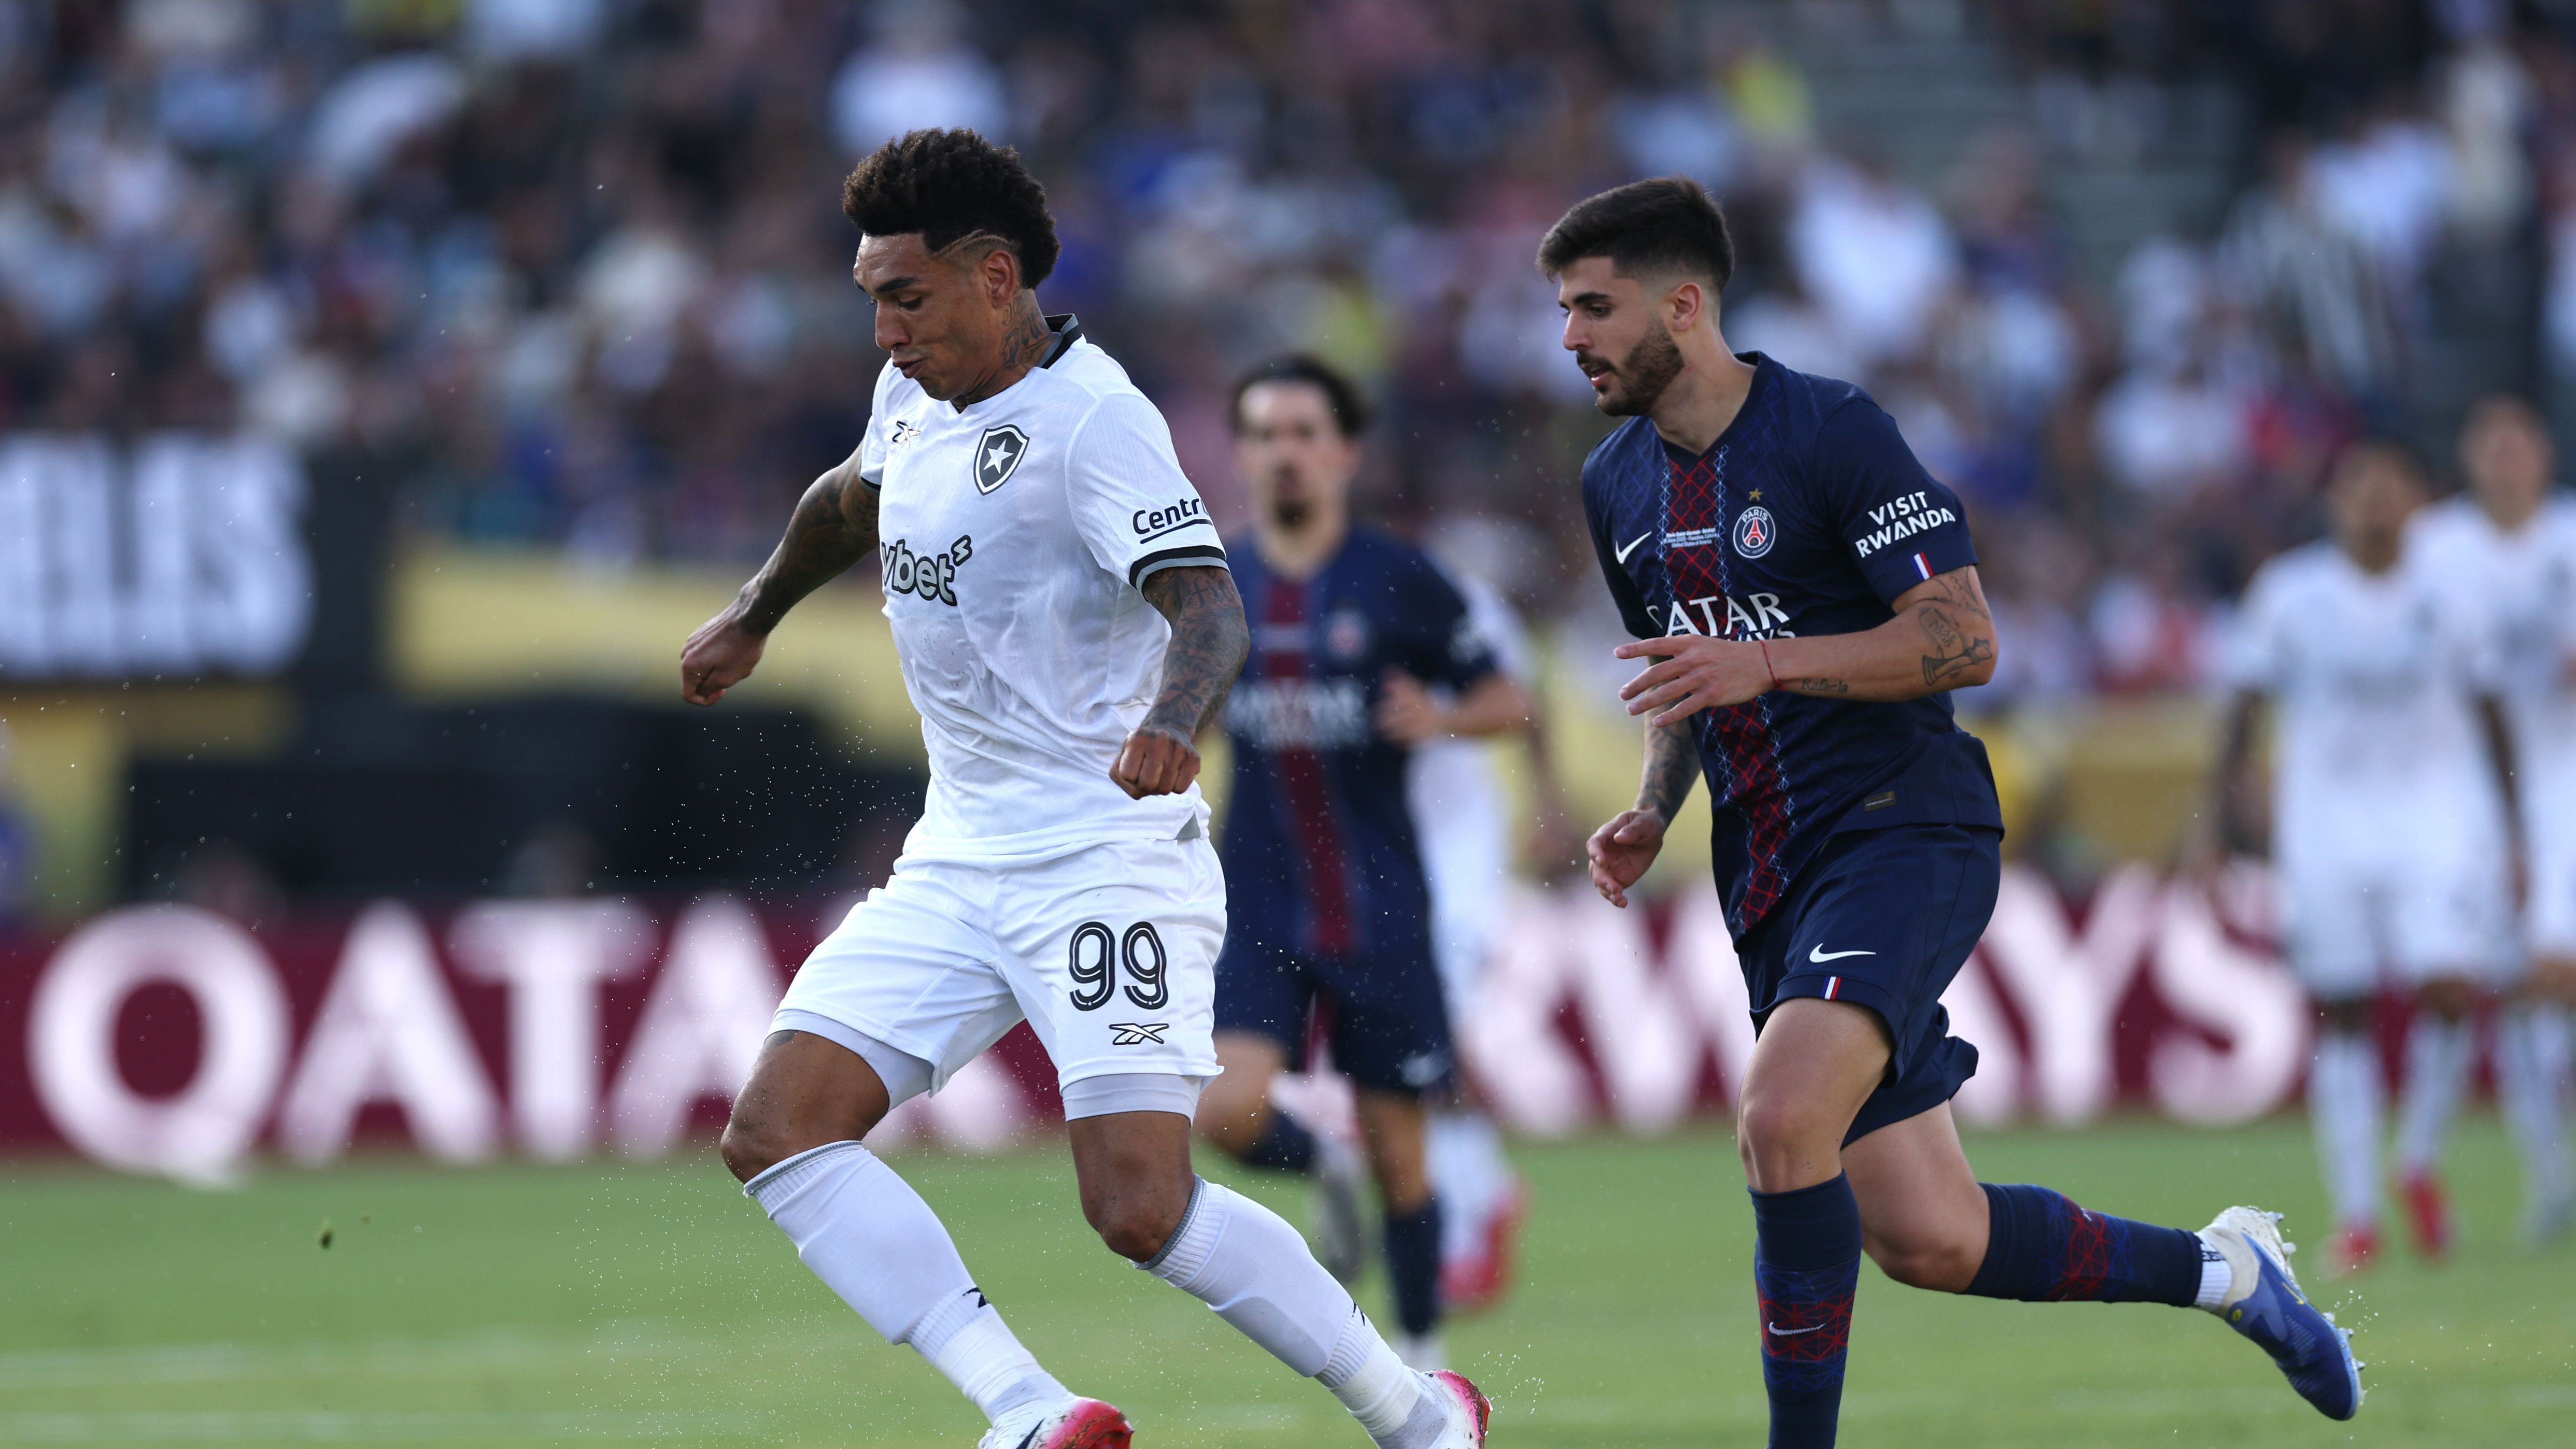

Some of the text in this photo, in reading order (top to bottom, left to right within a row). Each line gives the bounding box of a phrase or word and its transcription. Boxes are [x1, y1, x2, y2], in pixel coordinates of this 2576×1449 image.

[1133, 499, 1210, 534] Centr
[1742, 509, 1768, 522] PARIS
[1868, 491, 1928, 525] VISIT
[1855, 508, 1956, 558] RWANDA
[1646, 592, 1790, 636] ATAR
[1069, 921, 1169, 1011] 99
